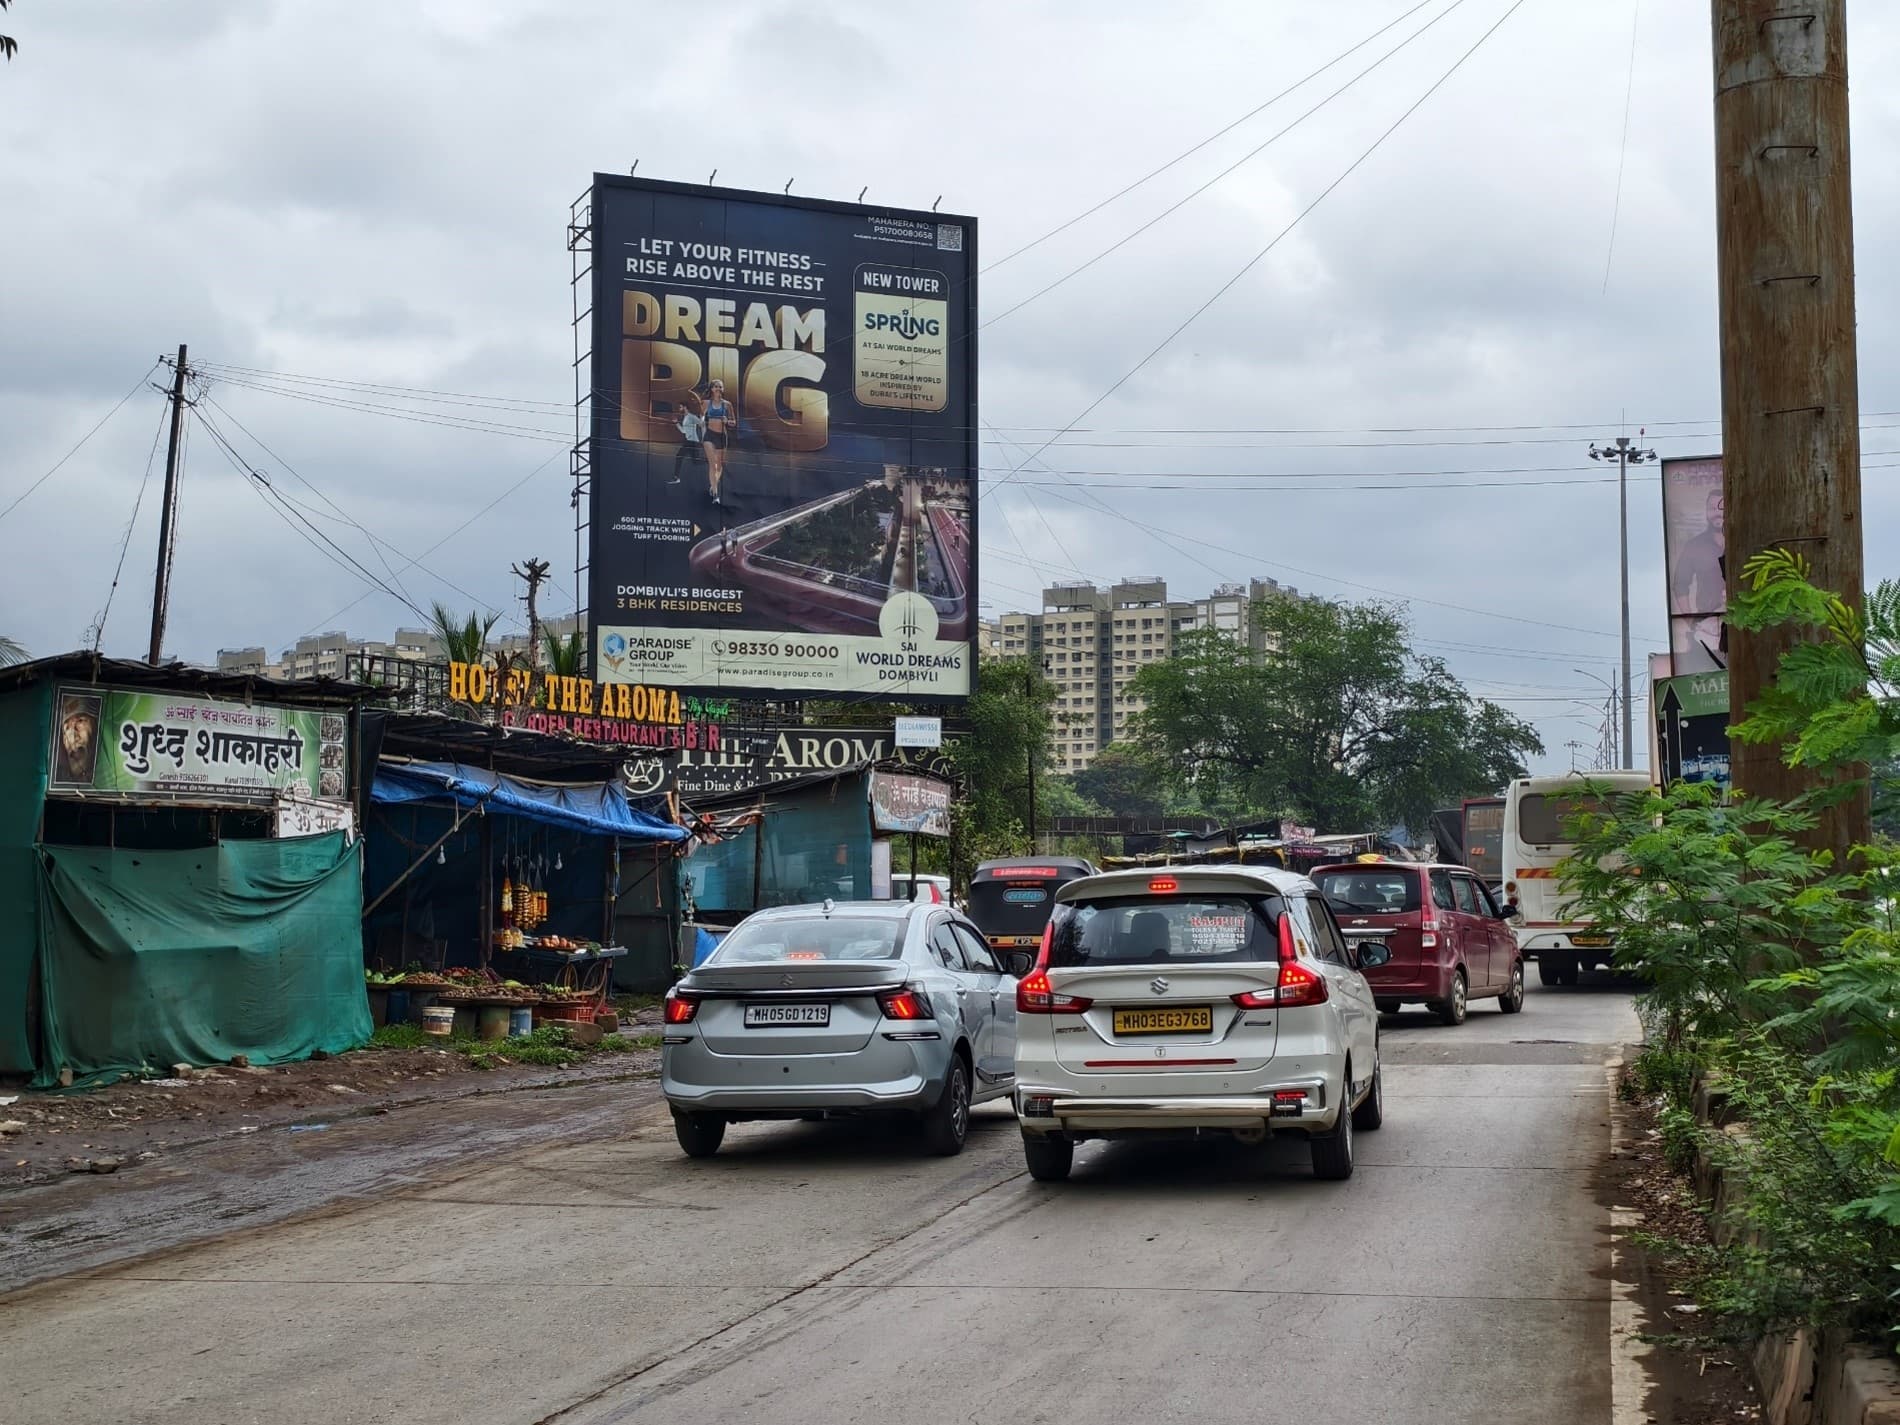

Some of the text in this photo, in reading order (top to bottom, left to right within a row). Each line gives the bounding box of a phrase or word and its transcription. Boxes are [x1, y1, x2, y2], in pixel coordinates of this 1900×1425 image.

[867, 217, 914, 229] MAHARERA
[640, 238, 811, 270] LET YOUR FITNESS
[626, 258, 824, 291] RISE ABOVE THE REST
[863, 272, 939, 293] NEW TOWER
[623, 289, 826, 353] DREAM
[865, 309, 940, 340] SPRING
[886, 344, 912, 352] WORLD
[913, 346, 942, 355] DREAMS
[870, 371, 888, 379] ACRE
[889, 373, 914, 382] DREAM
[916, 375, 942, 384] WORLD
[879, 381, 911, 390] INSPIRED
[620, 339, 829, 452] BIG
[870, 390, 934, 402] DUBAI'S LIFESTYLE
[612, 523, 690, 534] JOGGING TRACK WITH
[653, 518, 691, 526] ELEVATED
[653, 534, 690, 542] FLOORING
[617, 585, 743, 600] DOMBIVLI'S BIGGEST
[617, 598, 743, 613] 3 BHK RESIDENCES
[629, 638, 692, 650] PARADISE
[728, 641, 839, 659] 98330 90000
[901, 641, 918, 652] SAI
[629, 650, 674, 661] GROUP
[855, 652, 961, 669] WORLD DREAMS
[717, 667, 834, 679] www.paradisegroup.co.in
[879, 669, 938, 682] DOMBIVLI
[545, 674, 593, 715] THE
[601, 681, 682, 724] AROMA
[503, 710, 567, 735] GRDEN
[574, 717, 667, 746] RESTAURANT
[672, 728, 680, 747] &
[677, 780, 702, 792] Fine
[704, 780, 731, 791] Dine
[734, 780, 742, 790] &
[1123, 1012, 1208, 1029] MH03EG3768
